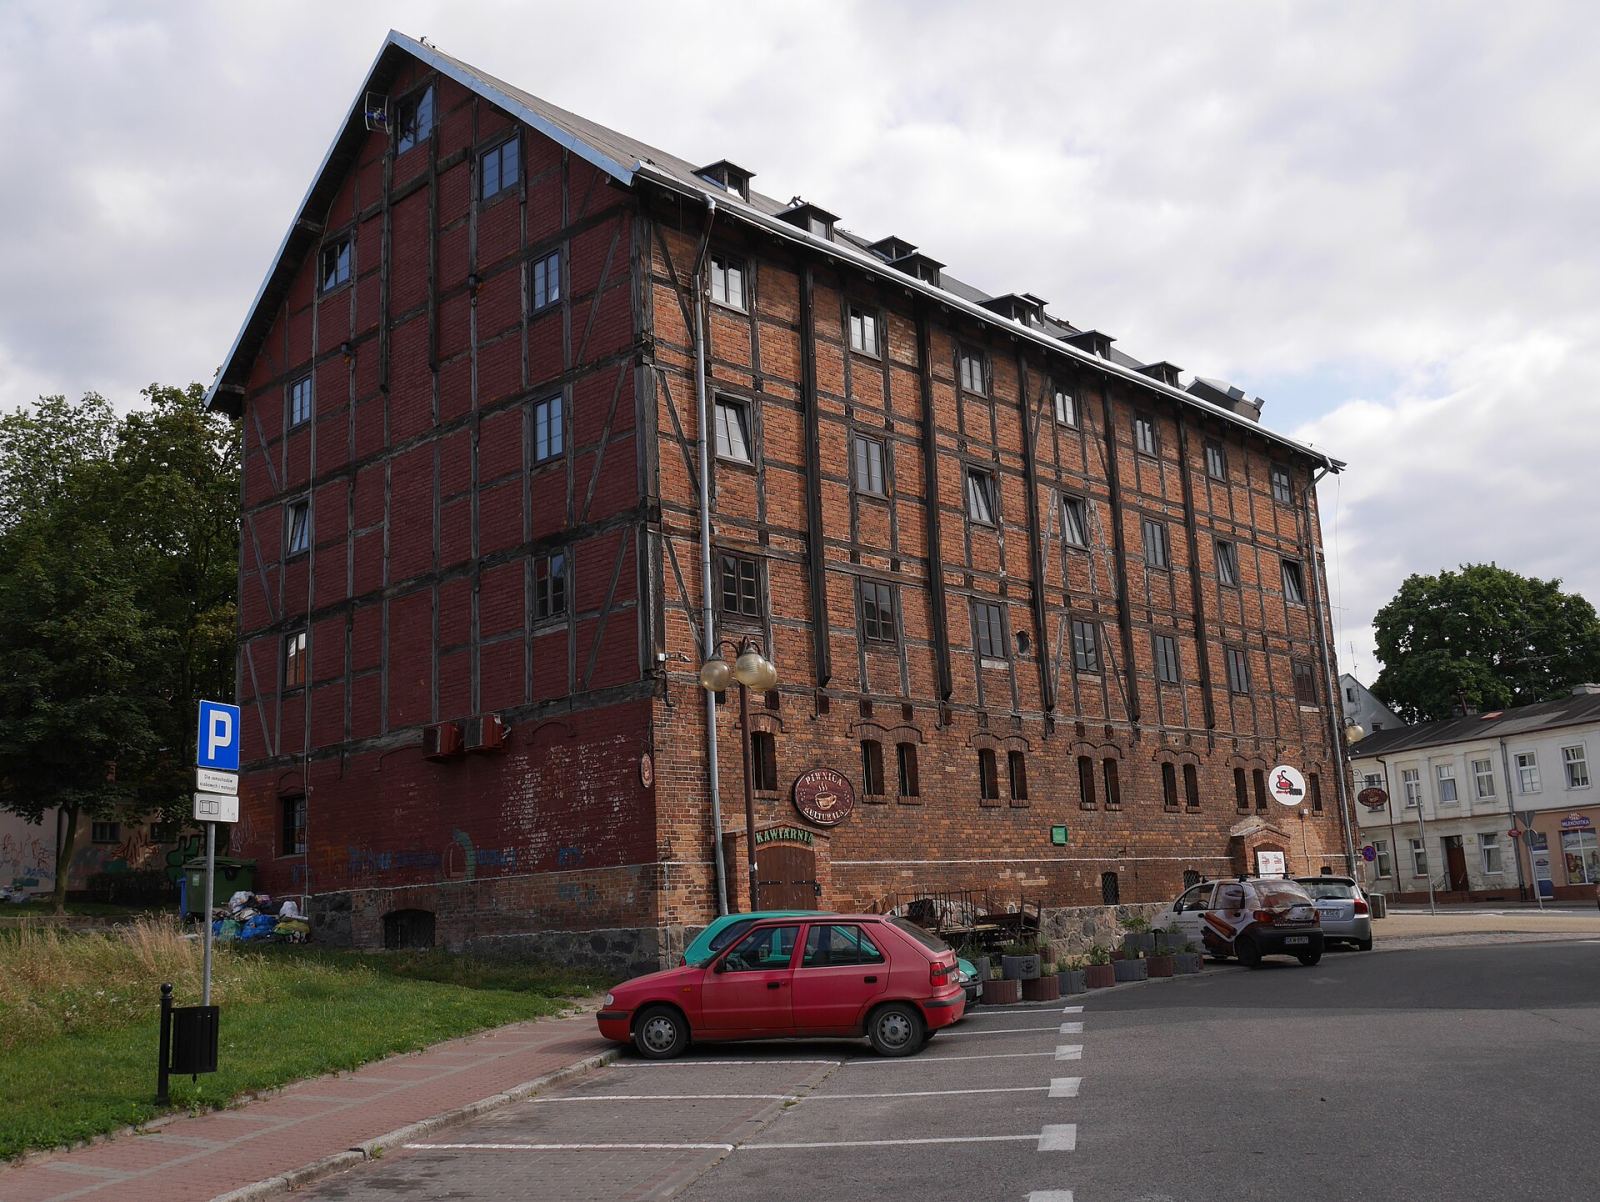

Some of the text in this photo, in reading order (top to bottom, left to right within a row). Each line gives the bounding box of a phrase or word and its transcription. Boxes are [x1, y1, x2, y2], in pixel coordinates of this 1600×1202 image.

[208, 709, 232, 760] P
[805, 772, 842, 786] PIWNICA
[804, 806, 848, 821] KULTURALNA
[756, 829, 813, 843] KAWIARNIA
